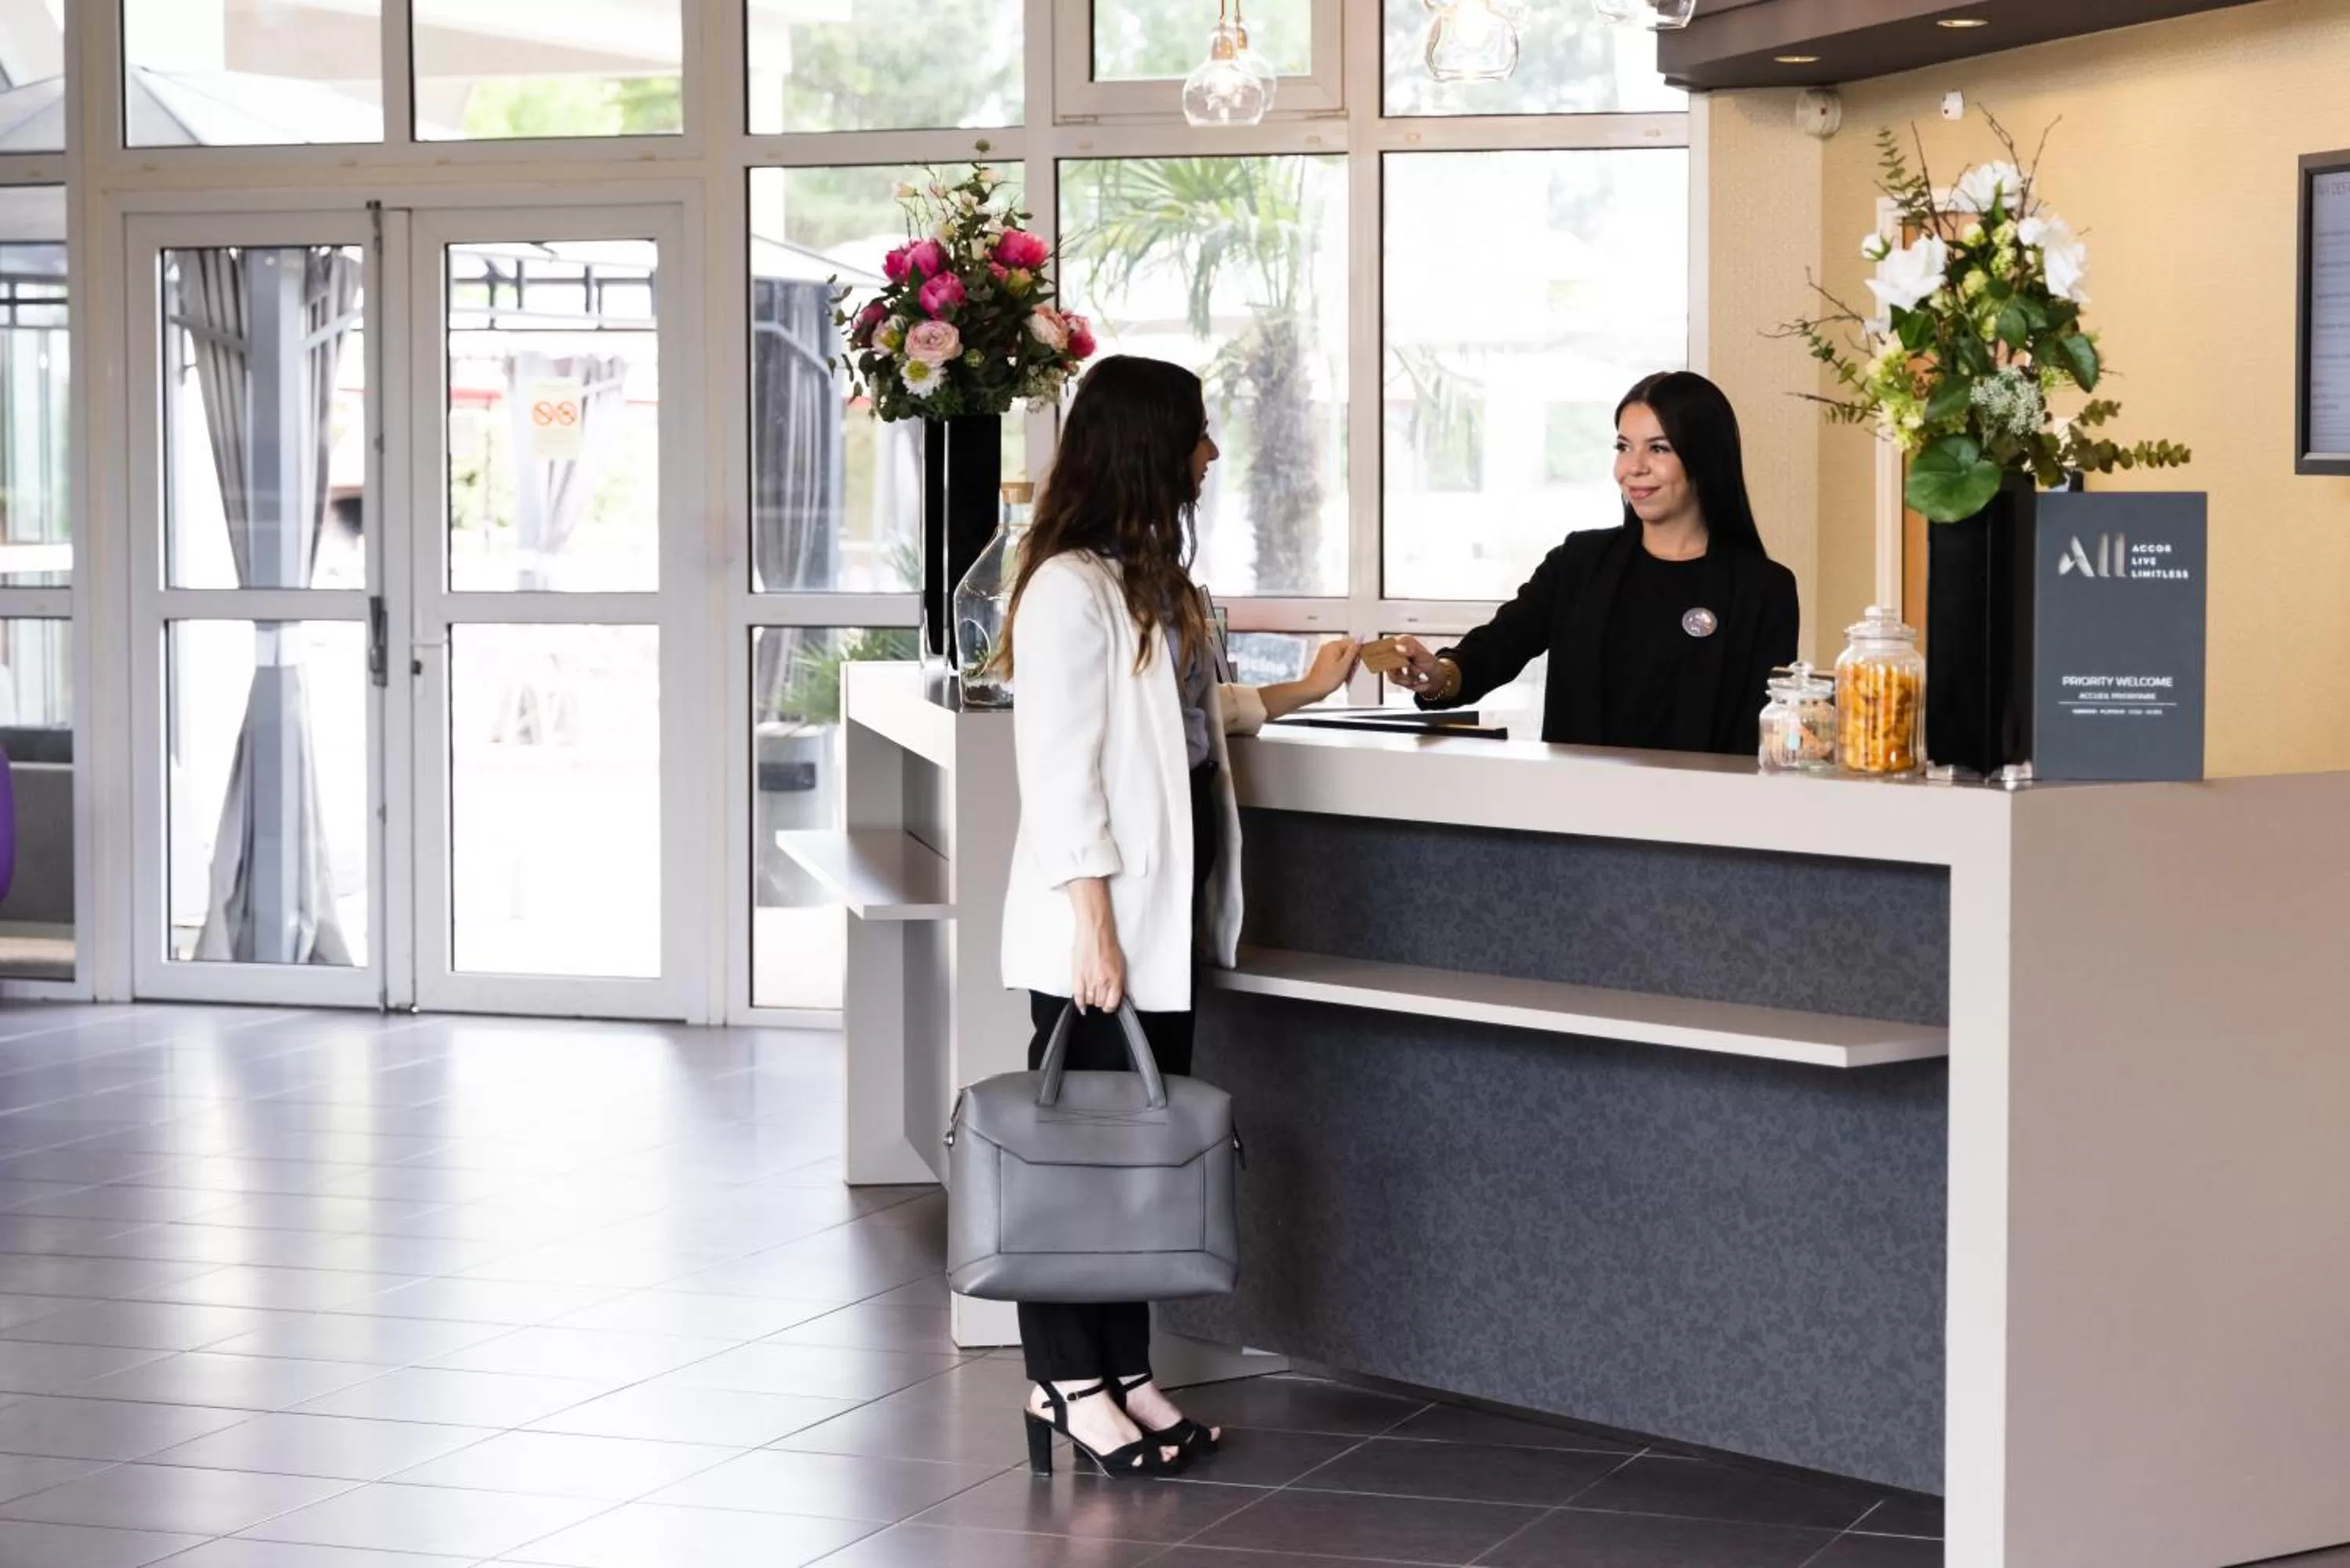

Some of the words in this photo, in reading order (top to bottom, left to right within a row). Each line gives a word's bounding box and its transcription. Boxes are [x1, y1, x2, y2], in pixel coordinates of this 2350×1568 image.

[2131, 544, 2172, 553] ACCOR
[2131, 557, 2157, 565] LIVE
[2131, 569, 2189, 579] LIMITLESS
[2062, 676, 2113, 687] PRIORITY
[2116, 676, 2173, 687] WELCOME
